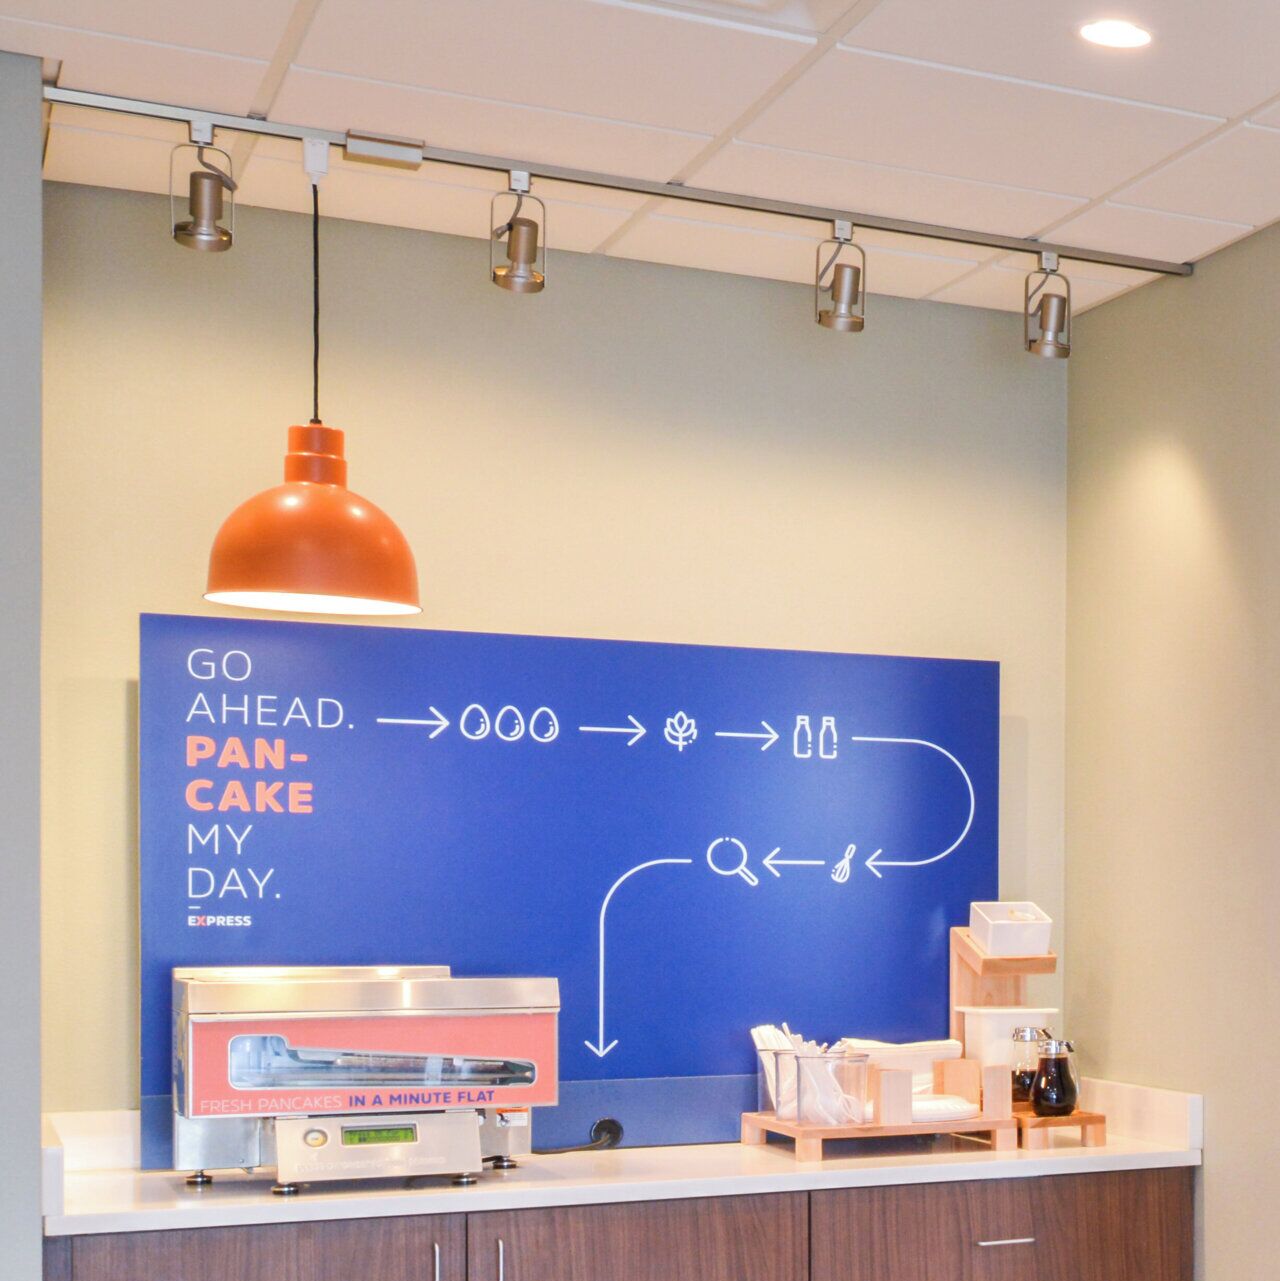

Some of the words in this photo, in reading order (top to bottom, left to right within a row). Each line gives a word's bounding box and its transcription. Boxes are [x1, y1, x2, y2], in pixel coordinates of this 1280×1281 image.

[187, 648, 252, 681] GO
[186, 692, 355, 730] AHEAD.
[185, 735, 309, 770] PAN-
[185, 778, 314, 814] CAKE
[187, 823, 253, 856] MY
[187, 866, 282, 899] DAY.
[187, 914, 252, 927] EXPRESS
[200, 1099, 253, 1113] FRESH
[257, 1094, 343, 1111] PANCAKES
[348, 1093, 369, 1107] IN
[371, 1092, 386, 1106] A
[388, 1090, 453, 1105] MINUTE
[457, 1089, 495, 1103] FLAT
